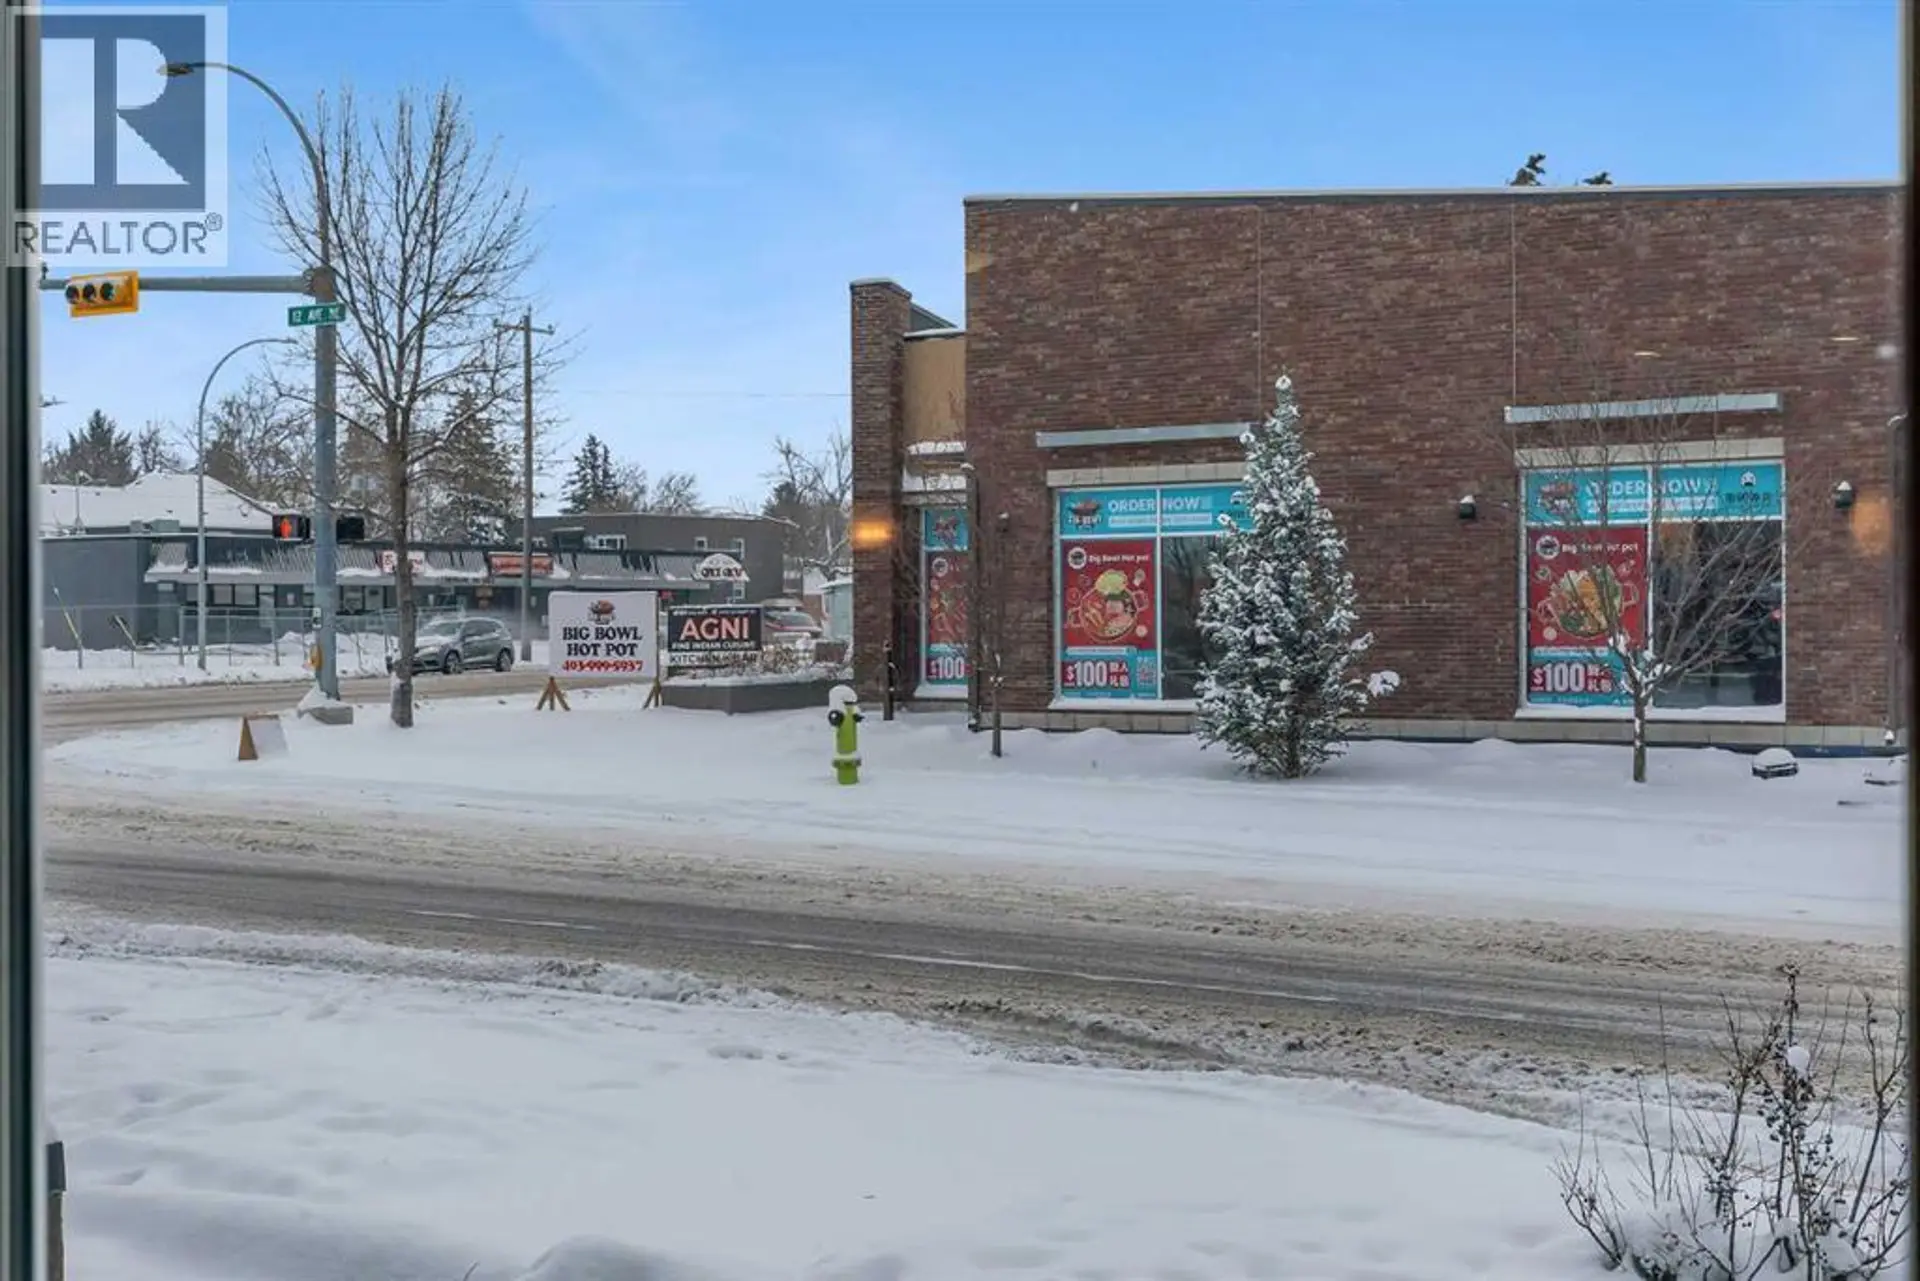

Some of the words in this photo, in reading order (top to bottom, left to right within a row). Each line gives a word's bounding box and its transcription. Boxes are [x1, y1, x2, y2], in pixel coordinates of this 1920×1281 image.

[1107, 498, 1157, 513] ORDER
[1161, 496, 1200, 511] NOW
[562, 626, 591, 640] BIG
[594, 626, 642, 641] BOWL
[680, 616, 749, 640] AGNI
[566, 643, 601, 656] HOT
[605, 643, 638, 656] POT
[1065, 660, 1108, 687] $100
[1532, 662, 1585, 692] $100
